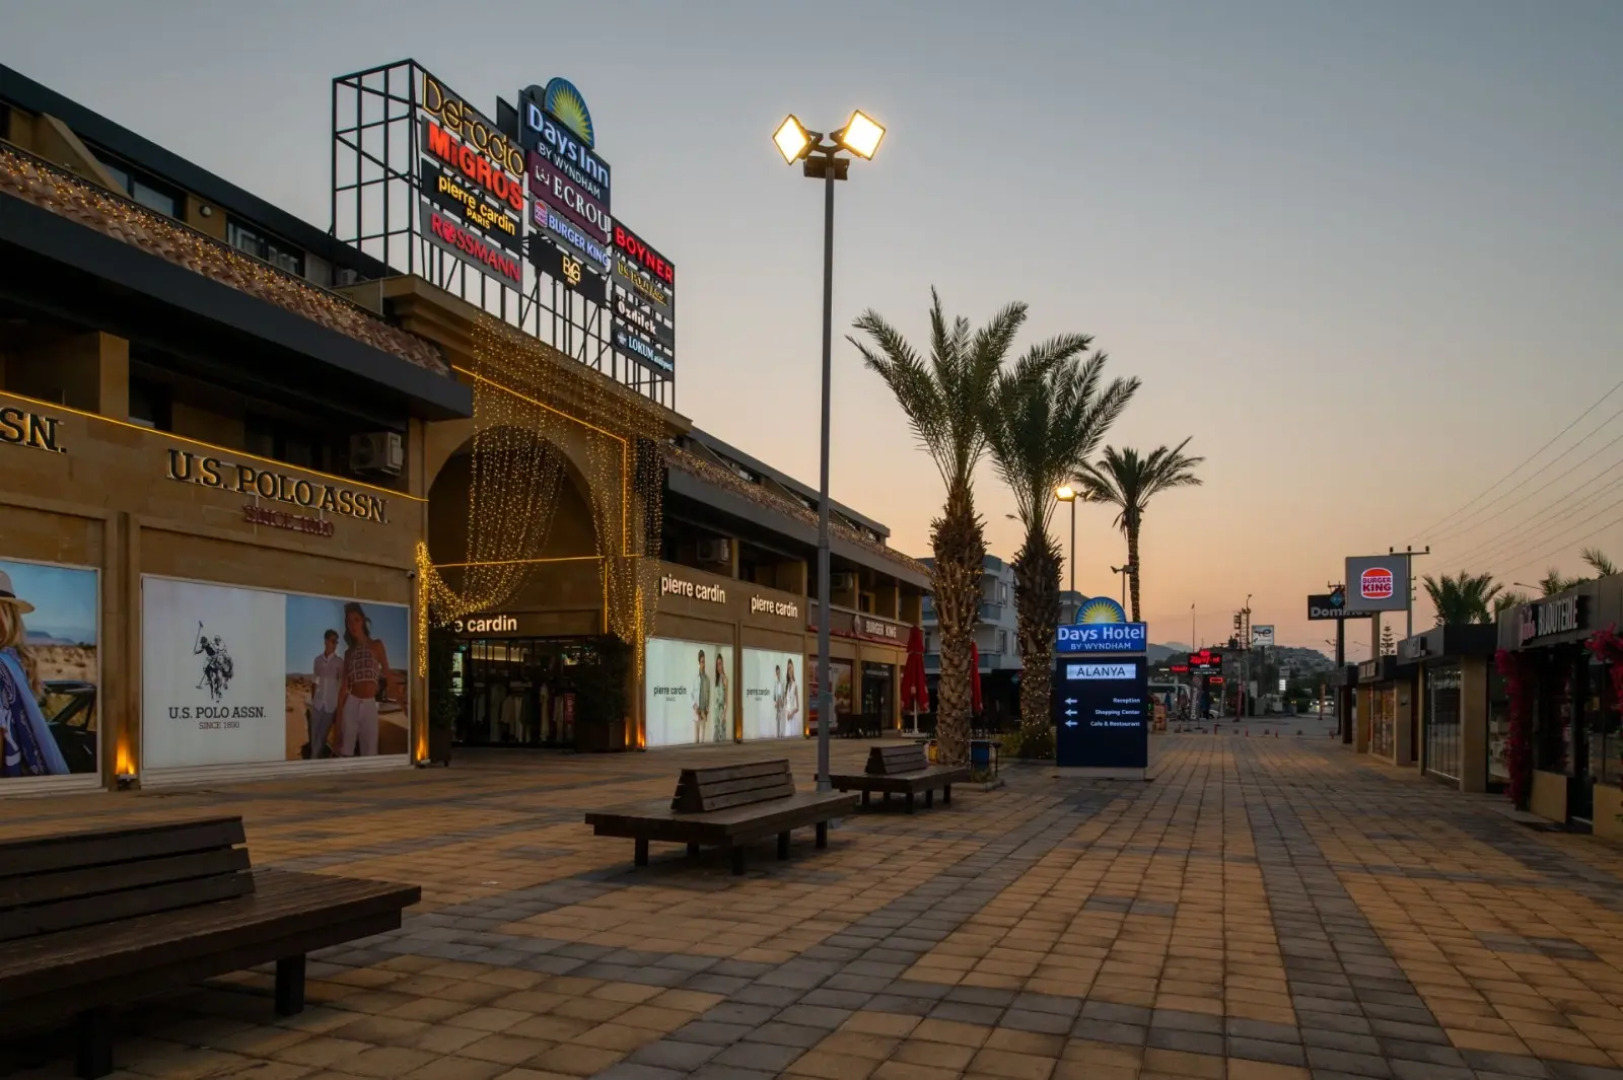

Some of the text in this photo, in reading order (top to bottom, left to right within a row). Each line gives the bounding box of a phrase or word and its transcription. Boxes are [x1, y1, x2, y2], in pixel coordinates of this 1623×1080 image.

[422, 72, 526, 179] DeFacto
[529, 102, 608, 188] Days Inn
[538, 142, 600, 199] BY WYNDHAM
[438, 175, 476, 209] pierre
[480, 203, 516, 236] cardin
[466, 207, 490, 230] PARIS
[432, 212, 520, 282] ROSSMANN
[548, 214, 608, 266] BURGER KING
[614, 225, 674, 284] BOYNER
[618, 296, 656, 335] Özdilek
[628, 336, 654, 361] LOKUM
[166, 448, 228, 489] U.S.
[236, 464, 312, 506] POLO
[661, 574, 726, 604] pierre cardin
[1362, 576, 1392, 592] BURGER KING
[751, 594, 798, 618] pierre cardin
[467, 614, 518, 632] cardin
[1058, 626, 1144, 642] Days Hotel
[1076, 667, 1126, 676] ALANYA
[654, 685, 686, 696] pierre cardin
[168, 706, 266, 719] U.S. POLO ASSN.
